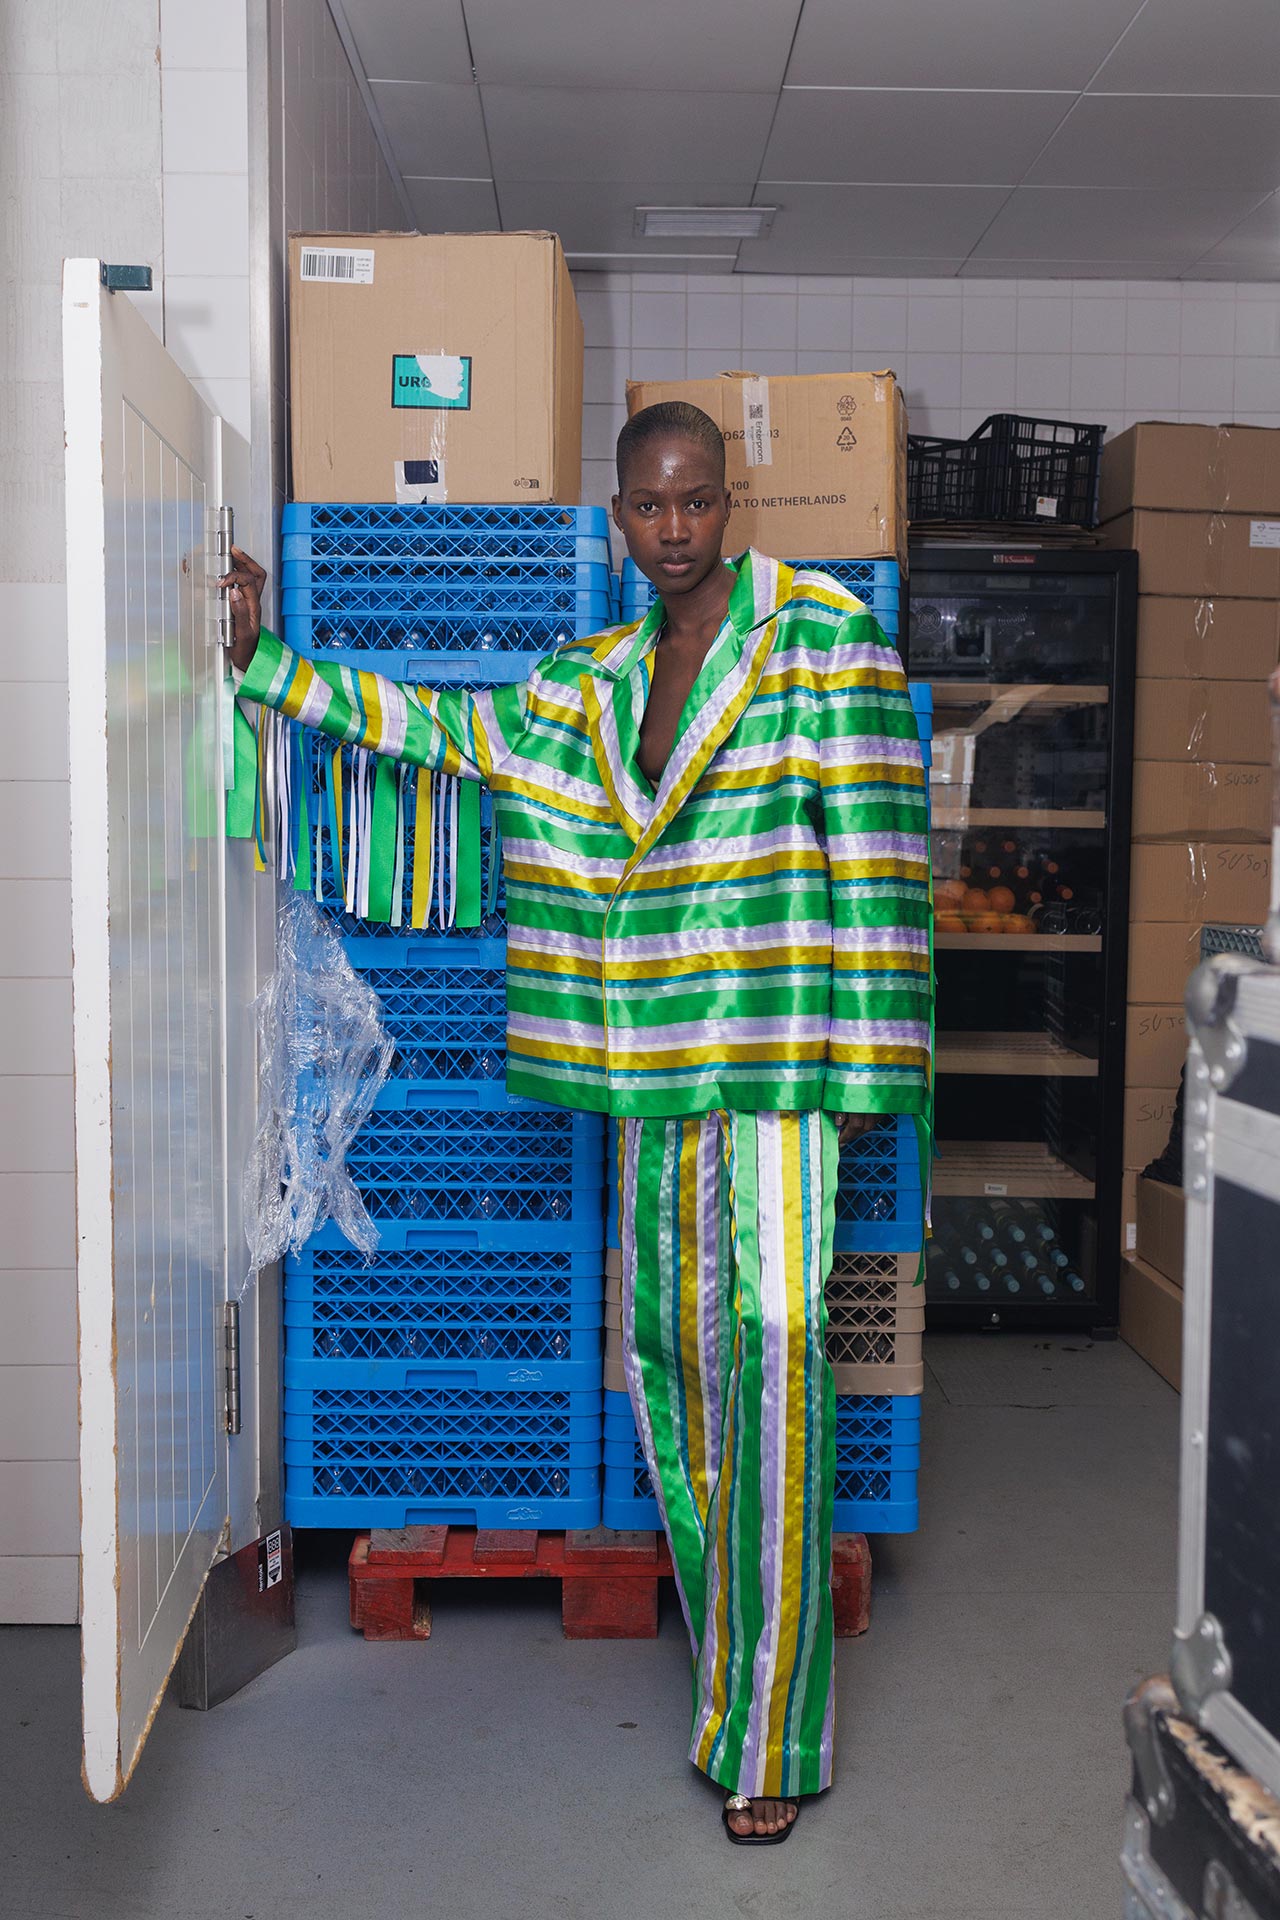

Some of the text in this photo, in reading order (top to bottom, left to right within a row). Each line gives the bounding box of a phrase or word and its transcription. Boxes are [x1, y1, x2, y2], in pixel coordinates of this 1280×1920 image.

[730, 480, 750, 491] 100
[743, 498, 759, 509] TO
[761, 494, 847, 508] NETHERLANDS
